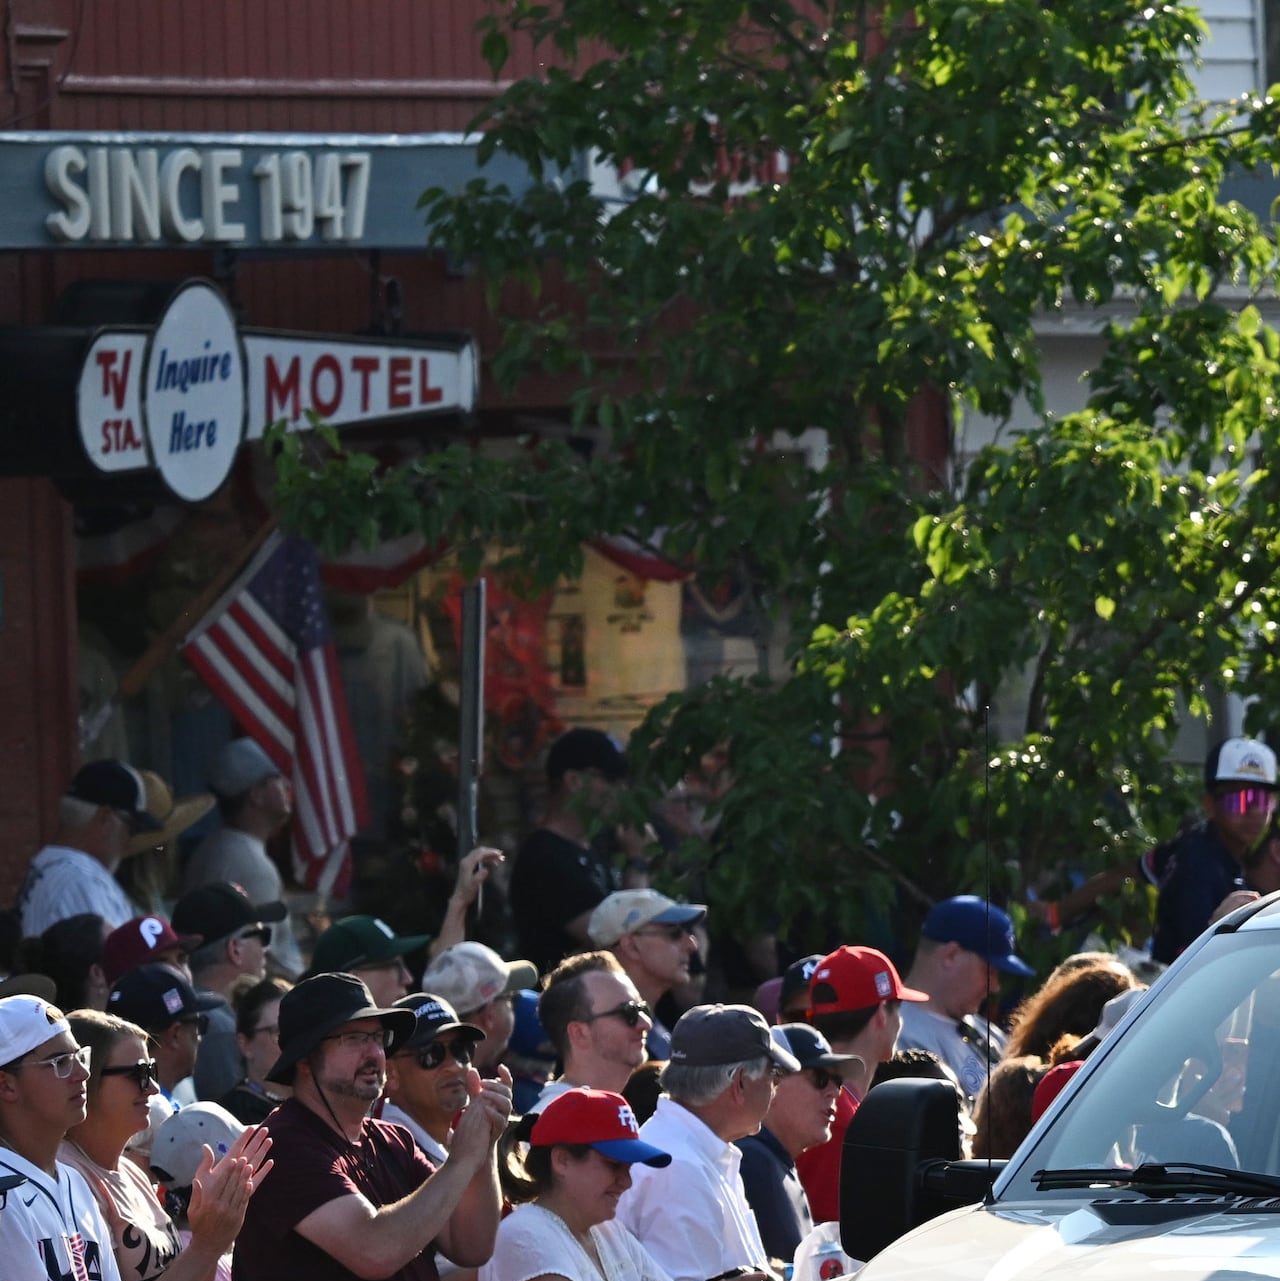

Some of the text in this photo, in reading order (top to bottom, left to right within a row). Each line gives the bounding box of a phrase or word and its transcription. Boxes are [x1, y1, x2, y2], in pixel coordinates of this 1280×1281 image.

[46, 146, 371, 243] SINCE 1947
[96, 350, 132, 411] TV
[156, 342, 232, 394] Inquire
[264, 354, 443, 423] MOTEL
[100, 419, 142, 454] STA.
[168, 411, 217, 455] Here
[140, 918, 163, 949] P
